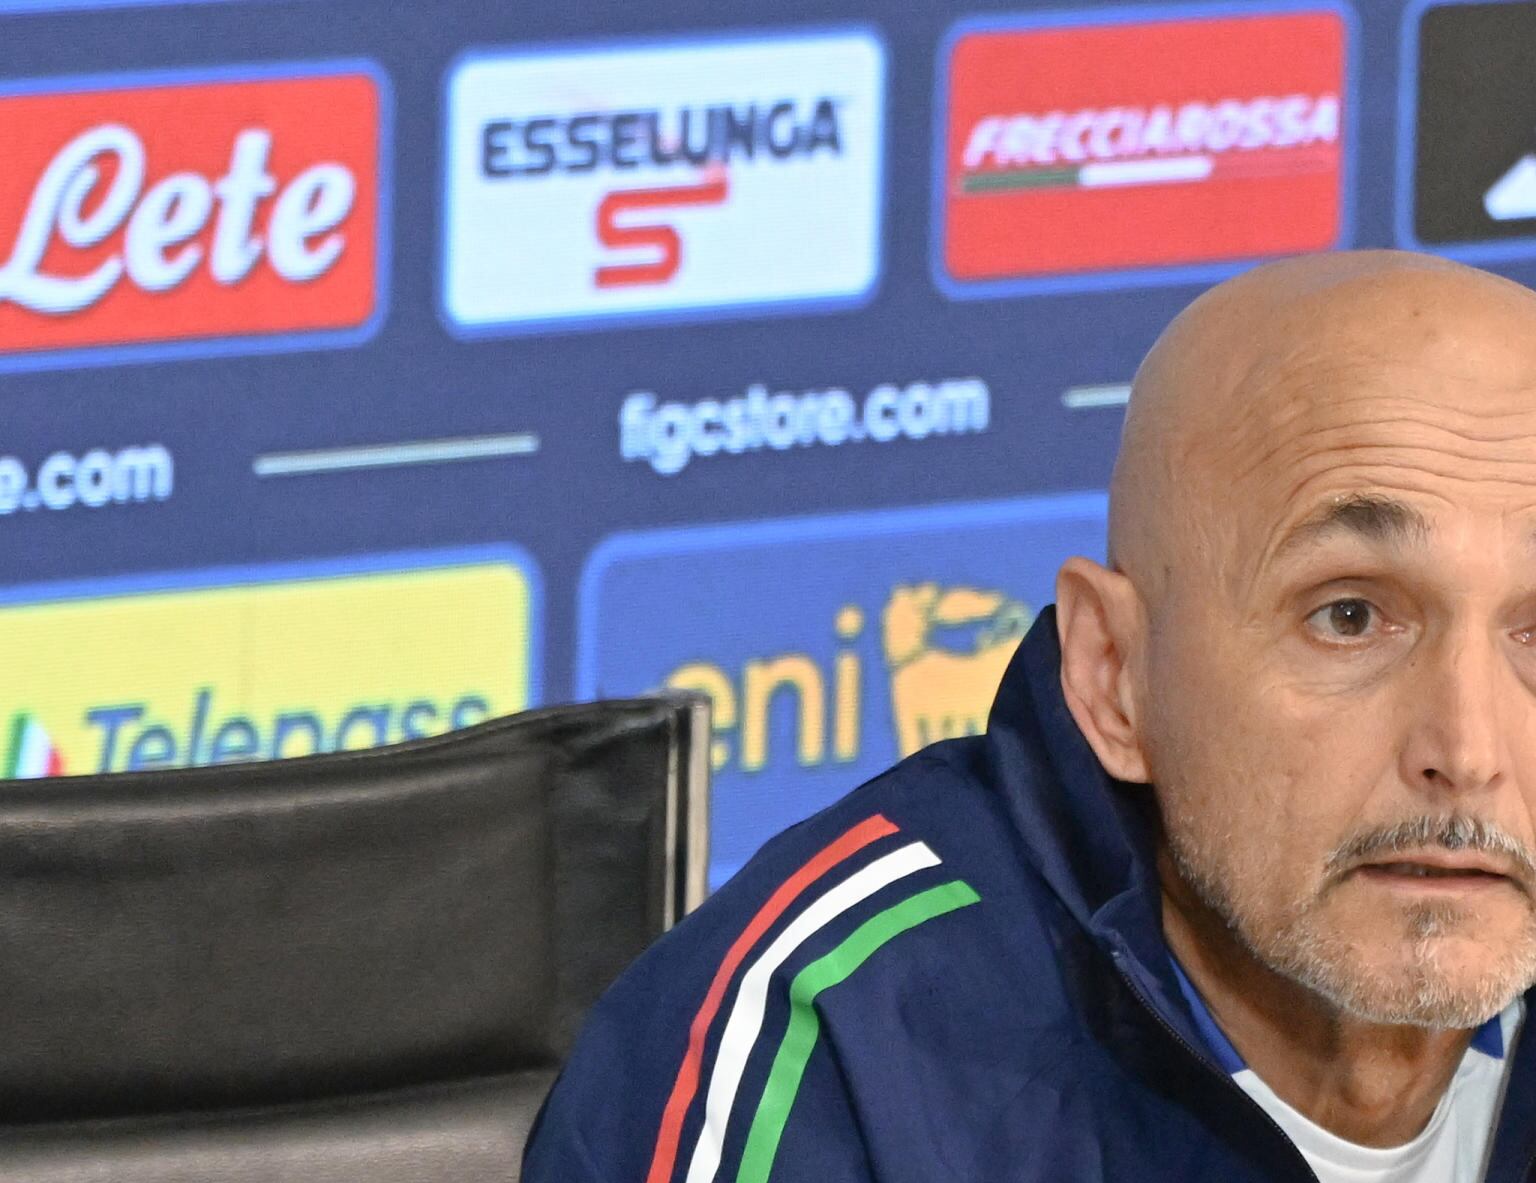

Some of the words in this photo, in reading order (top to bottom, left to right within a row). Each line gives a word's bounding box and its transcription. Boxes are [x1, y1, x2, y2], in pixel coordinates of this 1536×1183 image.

[482, 98, 842, 178] ESSELUNGA
[964, 96, 1340, 167] FRECCIAROSSA
[0, 124, 355, 313] Lete
[619, 377, 991, 475] figcstore.com
